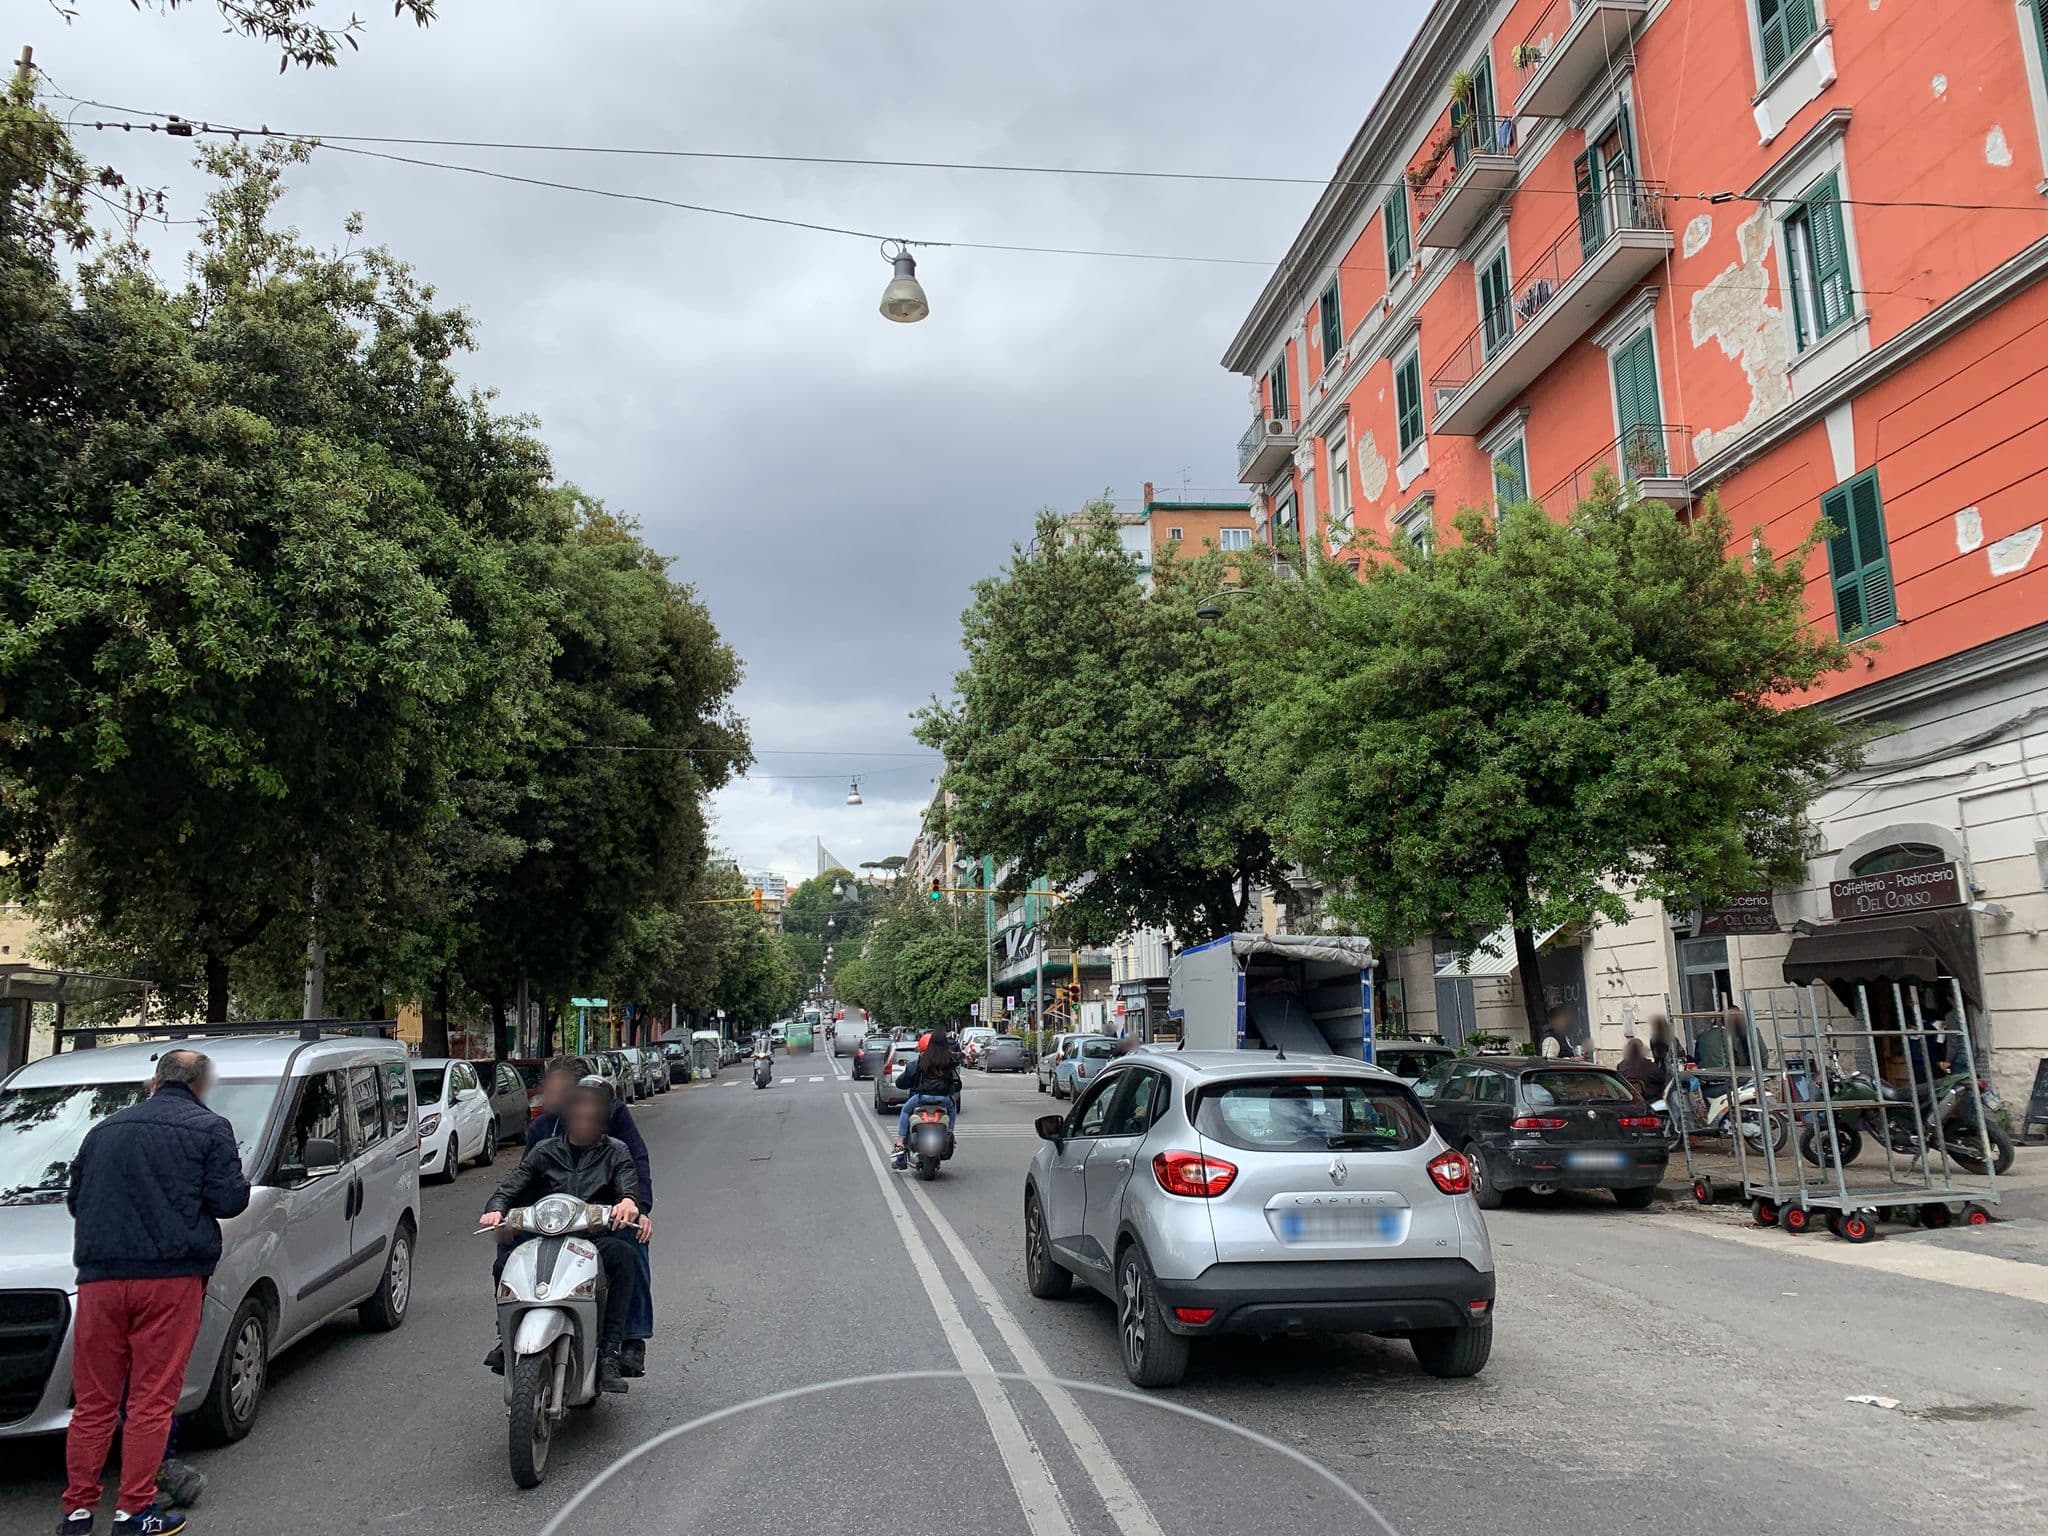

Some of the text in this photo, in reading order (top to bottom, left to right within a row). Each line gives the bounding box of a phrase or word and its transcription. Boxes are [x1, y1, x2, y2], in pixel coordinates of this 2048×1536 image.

[1833, 879, 1886, 897] Caffetteria
[1896, 867, 1954, 887] Pasticceria
[1295, 1196, 1385, 1206] CAPTUR
